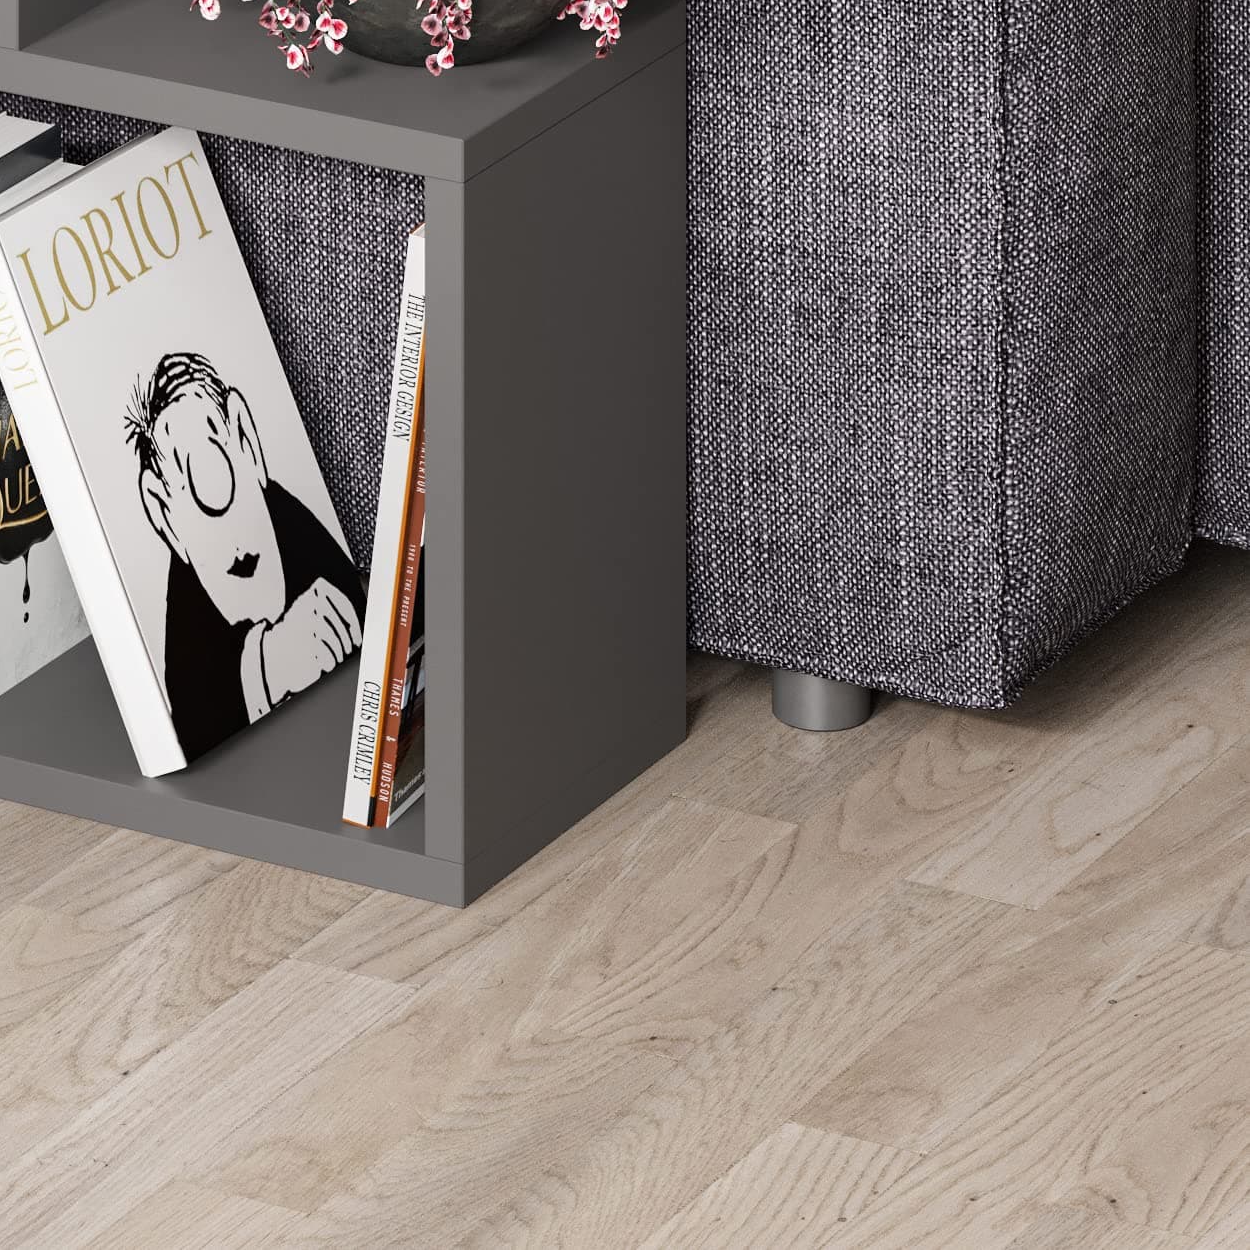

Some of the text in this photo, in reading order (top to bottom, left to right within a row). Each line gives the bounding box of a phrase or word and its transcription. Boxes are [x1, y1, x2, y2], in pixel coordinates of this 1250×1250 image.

[16, 150, 213, 336] LORIOT
[405, 292, 426, 322] THE
[399, 323, 422, 388] INTERIOR
[388, 677, 403, 717] THAMES
[353, 680, 382, 786] CHRIS CRIMLEY
[379, 762, 393, 803] HUDSON
